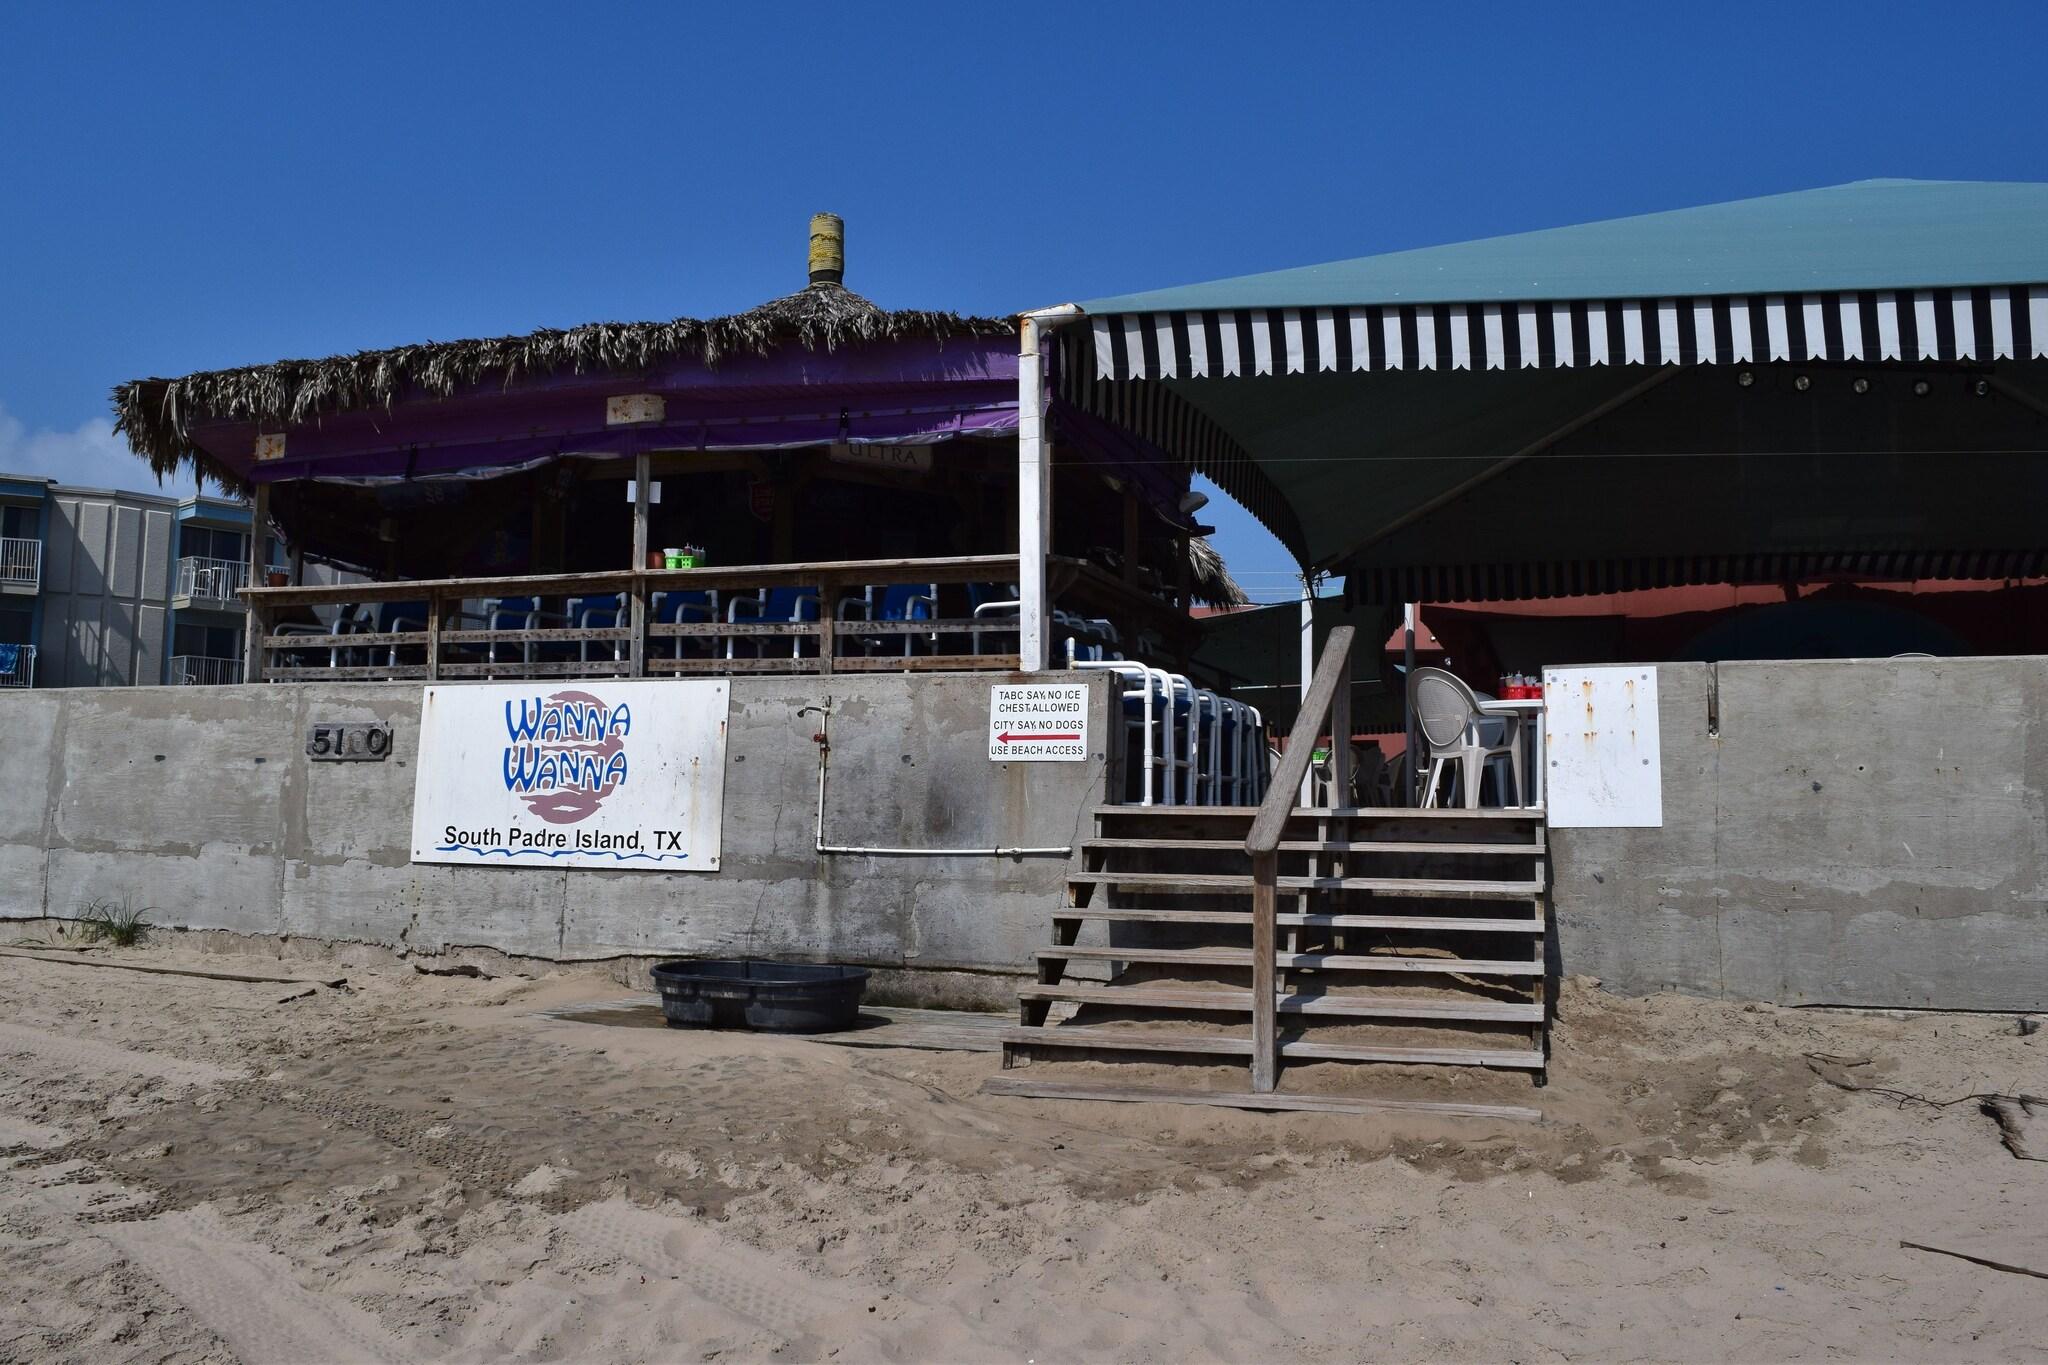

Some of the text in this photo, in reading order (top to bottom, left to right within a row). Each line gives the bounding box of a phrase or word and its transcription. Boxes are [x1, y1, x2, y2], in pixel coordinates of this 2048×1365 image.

[999, 691, 1023, 700] TABC
[1048, 690, 1062, 699] NO
[1064, 690, 1081, 699] ICE
[1032, 703, 1080, 712] ALLOWED
[505, 696, 631, 744] WANNA
[993, 720, 1014, 730] CITY
[1039, 720, 1053, 729] NO
[1056, 720, 1084, 729] DOGS
[312, 728, 388, 756] 510
[991, 745, 1084, 755] USE BEACH ACCESS
[503, 747, 628, 792] WANNA
[444, 825, 683, 853] South Padre Island, TX
